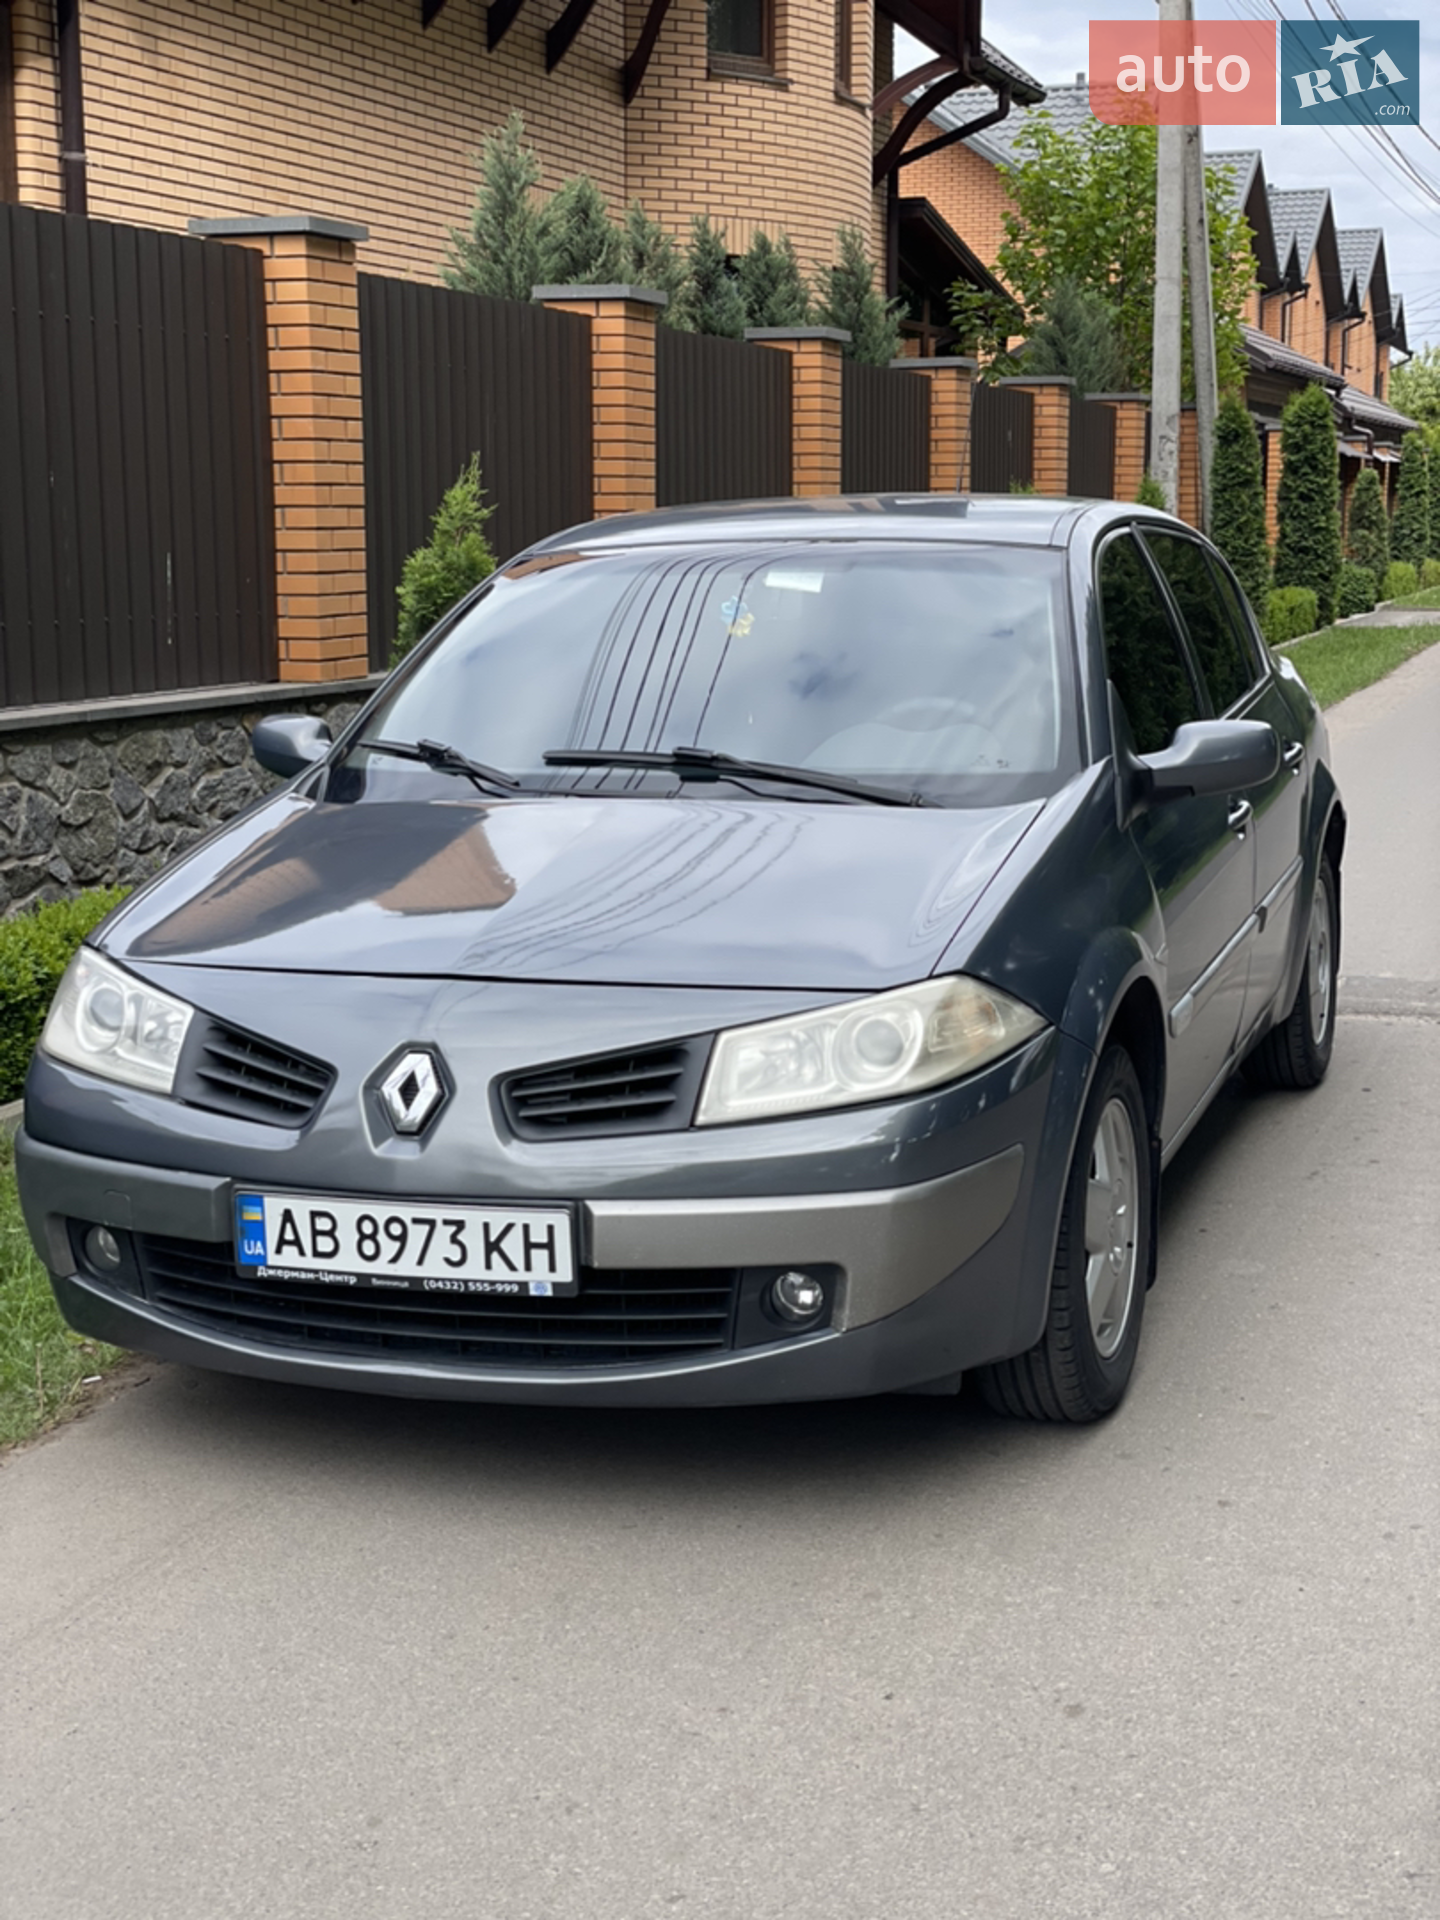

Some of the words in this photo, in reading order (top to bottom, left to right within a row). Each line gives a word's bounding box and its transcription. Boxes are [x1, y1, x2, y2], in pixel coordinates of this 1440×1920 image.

[244, 1238, 265, 1256] UA
[274, 1208, 340, 1260] AB
[355, 1213, 468, 1268] 8973
[482, 1220, 555, 1274] KH
[423, 1279, 464, 1293] (0432)
[468, 1282, 519, 1294] 555-999
